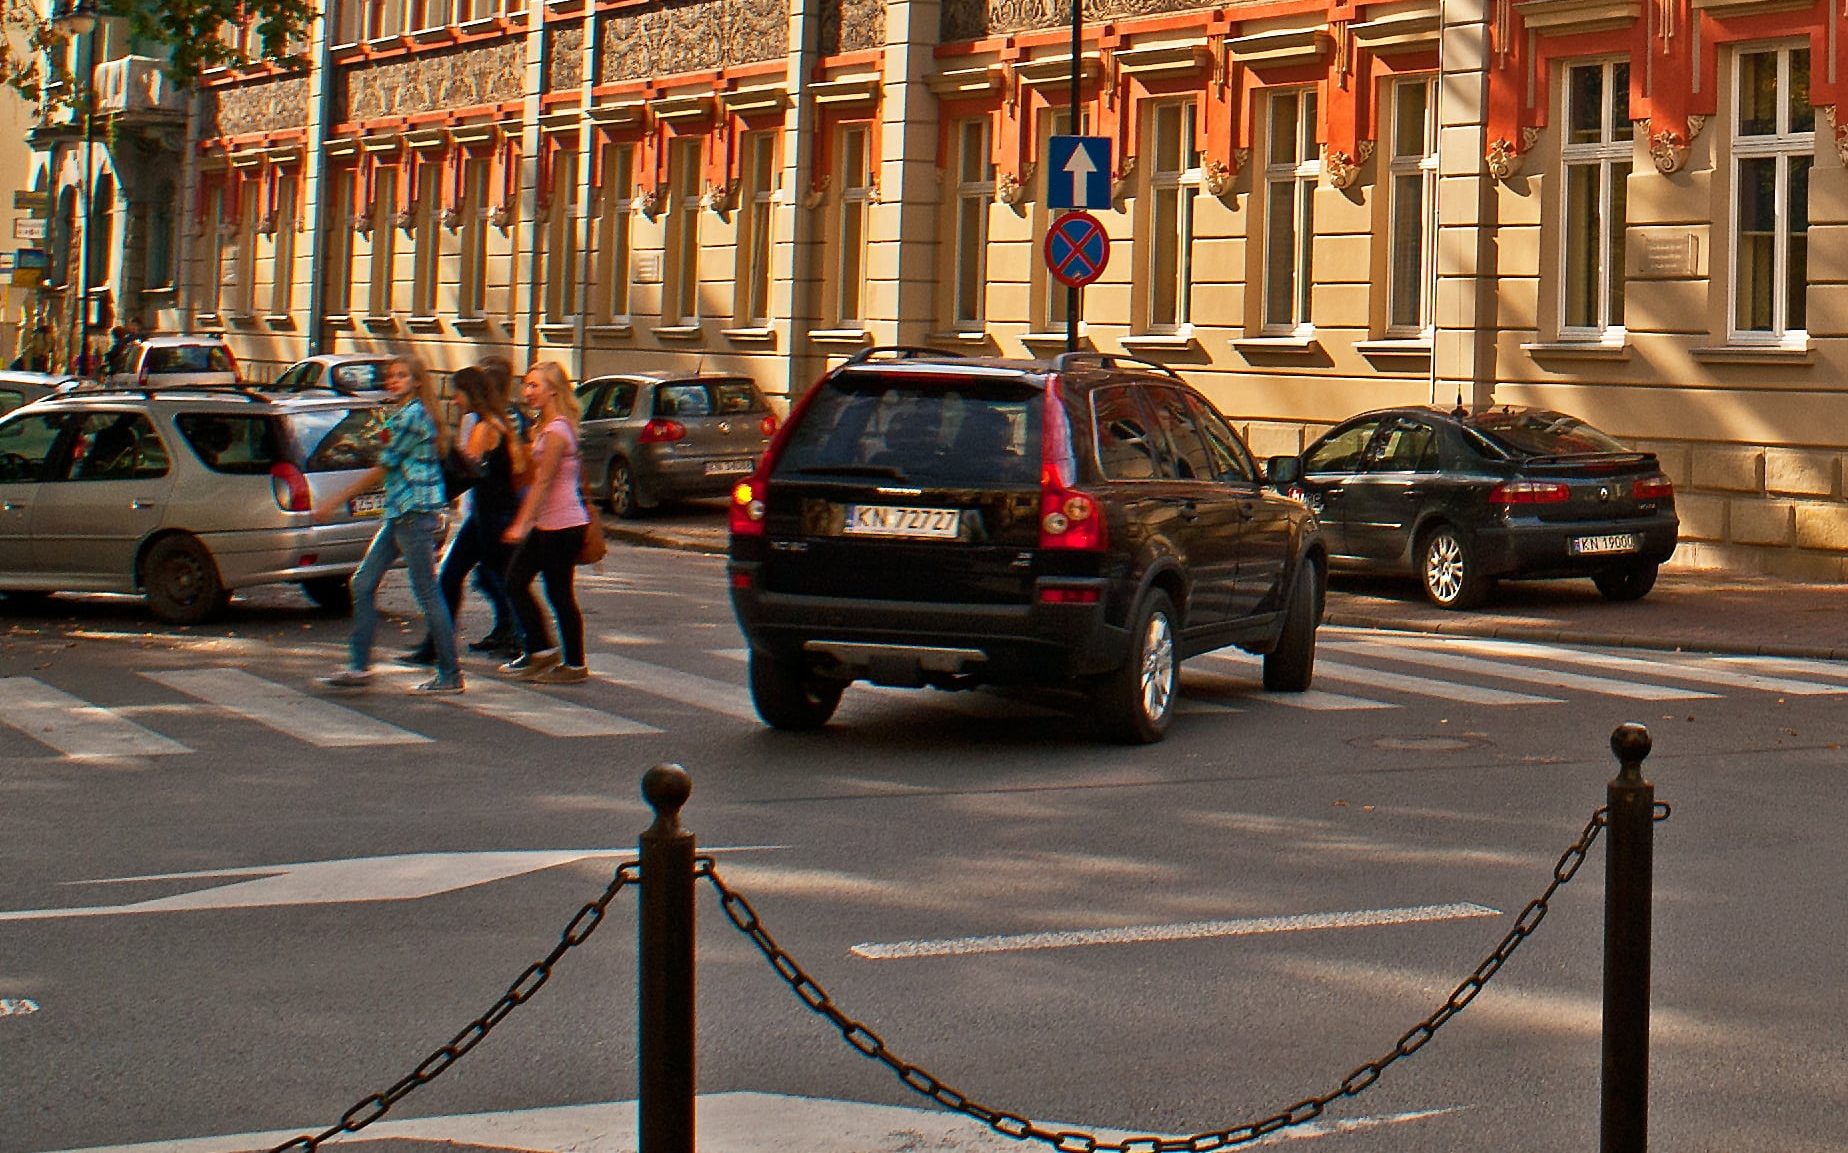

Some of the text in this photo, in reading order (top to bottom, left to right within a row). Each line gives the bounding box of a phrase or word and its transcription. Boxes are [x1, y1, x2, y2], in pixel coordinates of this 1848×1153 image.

[856, 507, 956, 531] KN 72727
[1581, 534, 1634, 550] KN 19000
